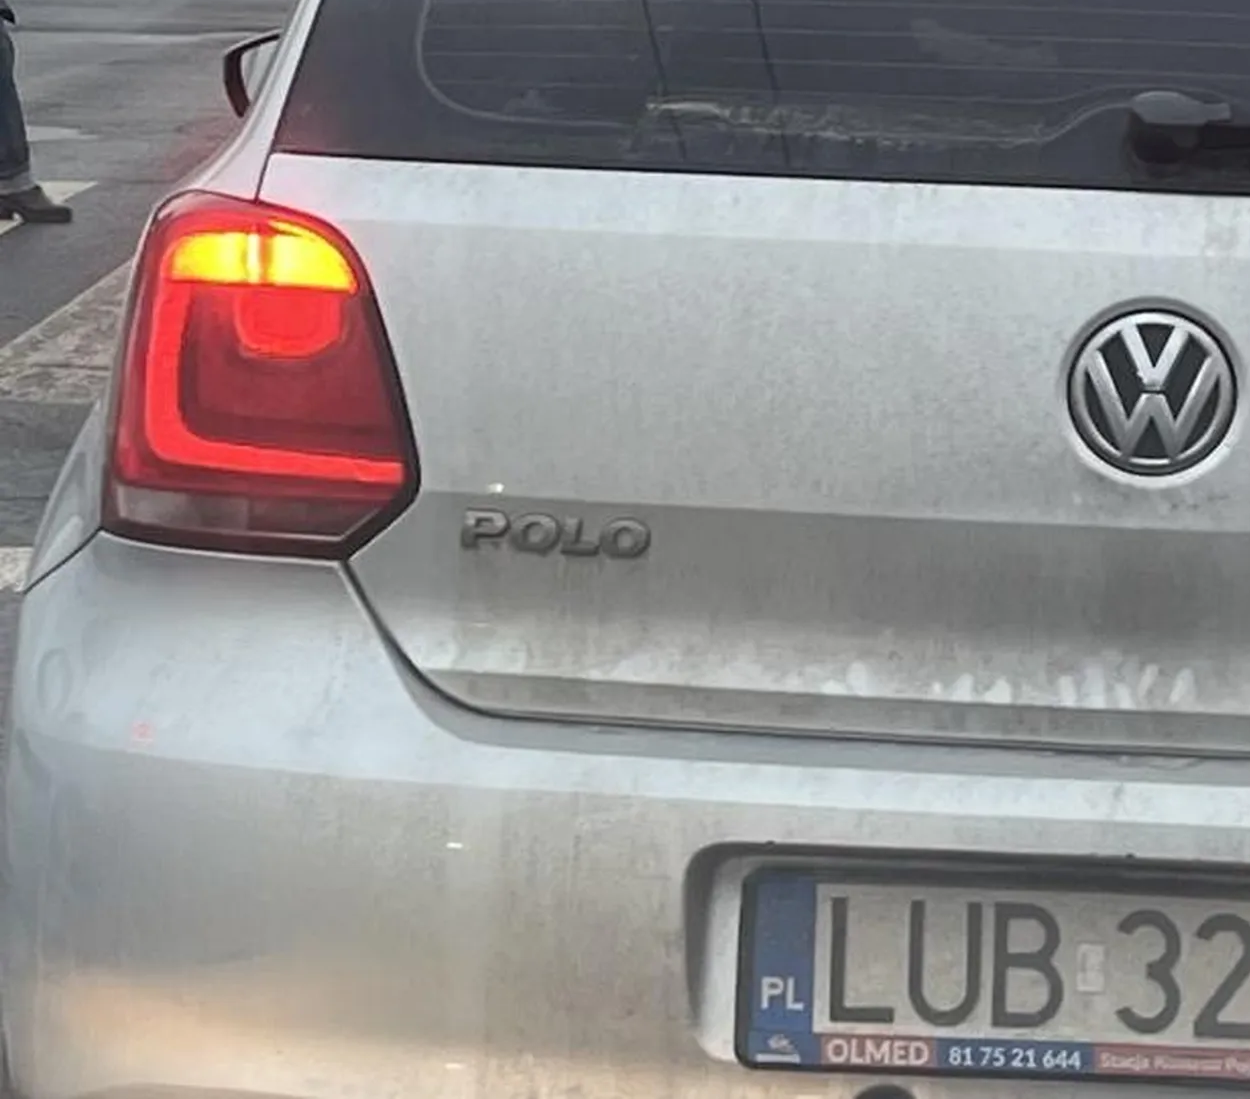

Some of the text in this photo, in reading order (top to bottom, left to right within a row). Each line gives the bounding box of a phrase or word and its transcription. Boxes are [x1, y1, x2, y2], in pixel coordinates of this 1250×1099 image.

[461, 507, 651, 560] POLO
[829, 896, 1064, 1028] LUB
[760, 975, 805, 1011] PL
[826, 1038, 930, 1066] OLMED
[948, 1047, 972, 1067] 81
[979, 1048, 1006, 1069] 75
[1011, 1049, 1038, 1069] 21
[1041, 1049, 1083, 1071] 644
